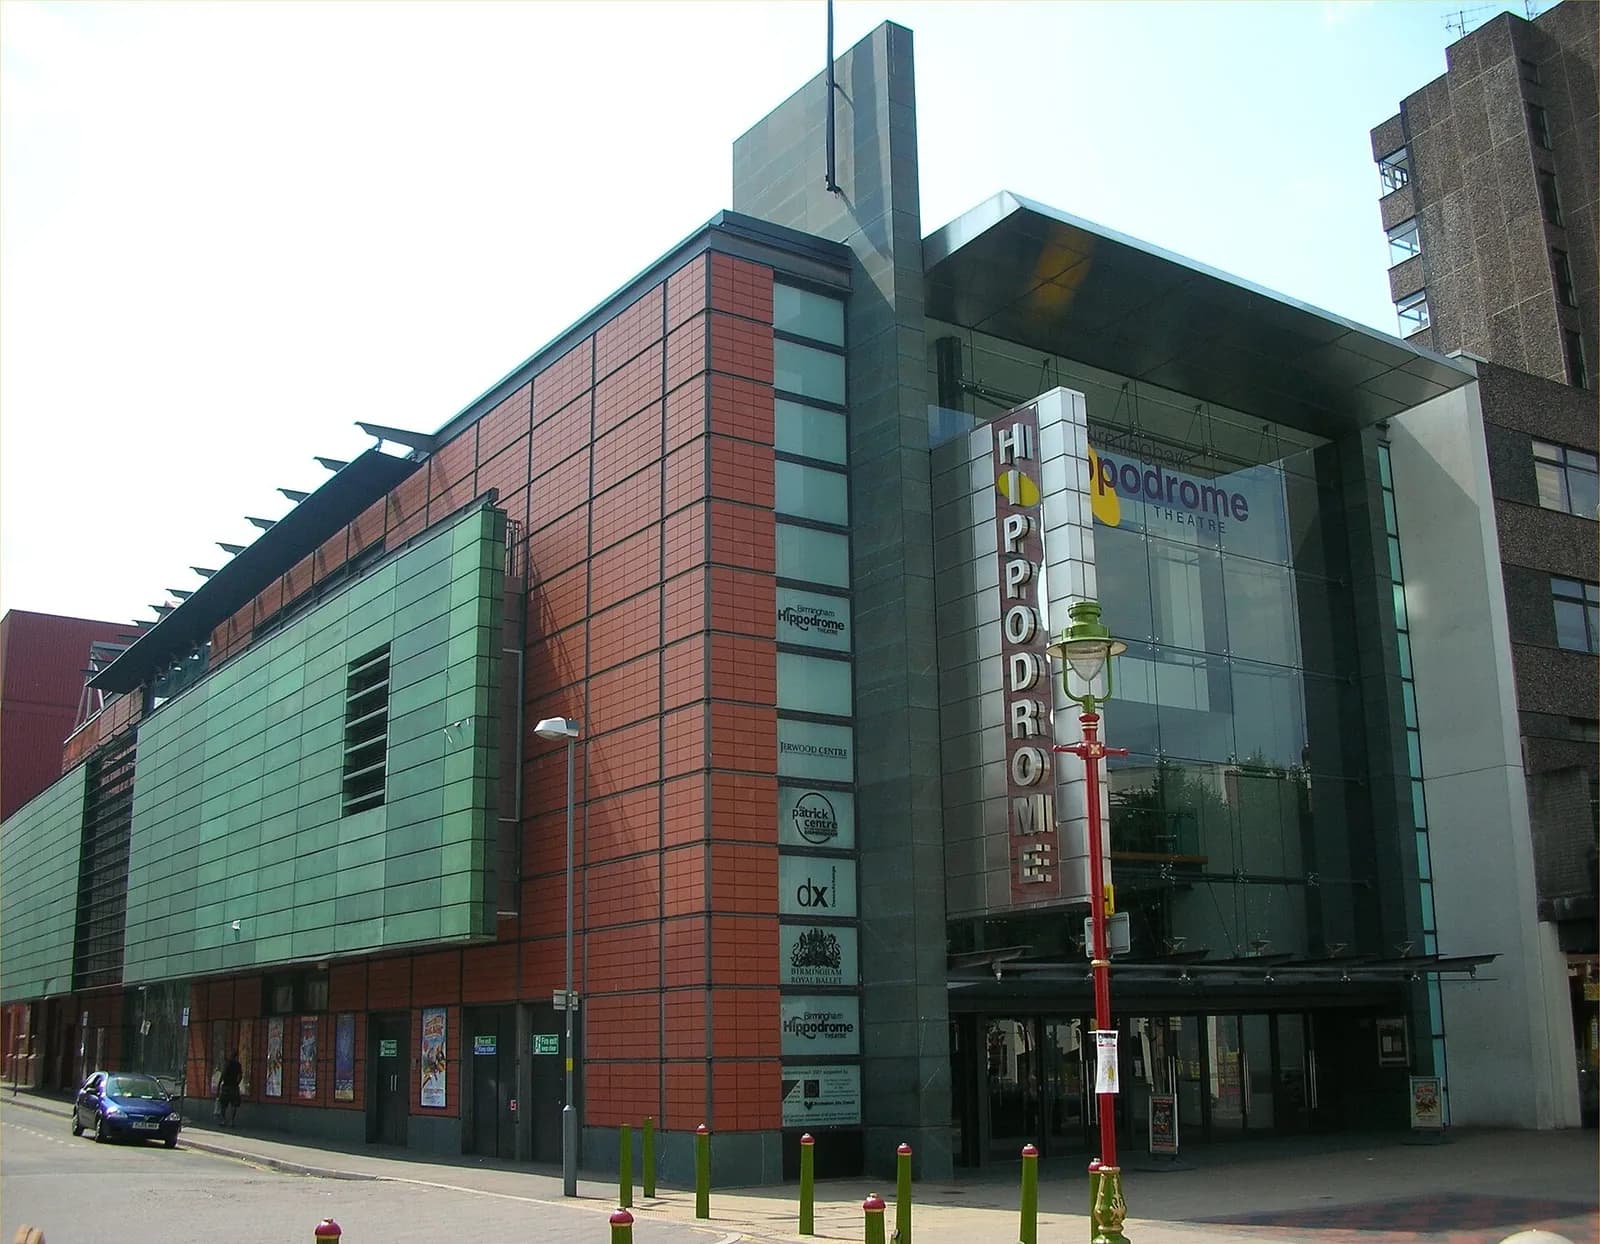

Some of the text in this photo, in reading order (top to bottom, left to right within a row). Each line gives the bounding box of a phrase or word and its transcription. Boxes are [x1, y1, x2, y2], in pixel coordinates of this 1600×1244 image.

[1088, 424, 1192, 471] irmingham
[1154, 505, 1226, 534] THEATRE
[797, 604, 835, 617] Birmingham
[778, 607, 845, 631] Hippodrome
[999, 421, 1053, 883] HIPPODROME
[780, 741, 817, 754] JERWOOD
[819, 746, 848, 757] CENTRE
[792, 807, 829, 820] patrick
[804, 819, 838, 829] centre
[797, 877, 829, 908] dx
[791, 967, 842, 976] BIRMINGHAM
[791, 976, 842, 985] ROYAL BALLET
[804, 1011, 843, 1021] Birmingham
[783, 1016, 854, 1039] Hippodrome
